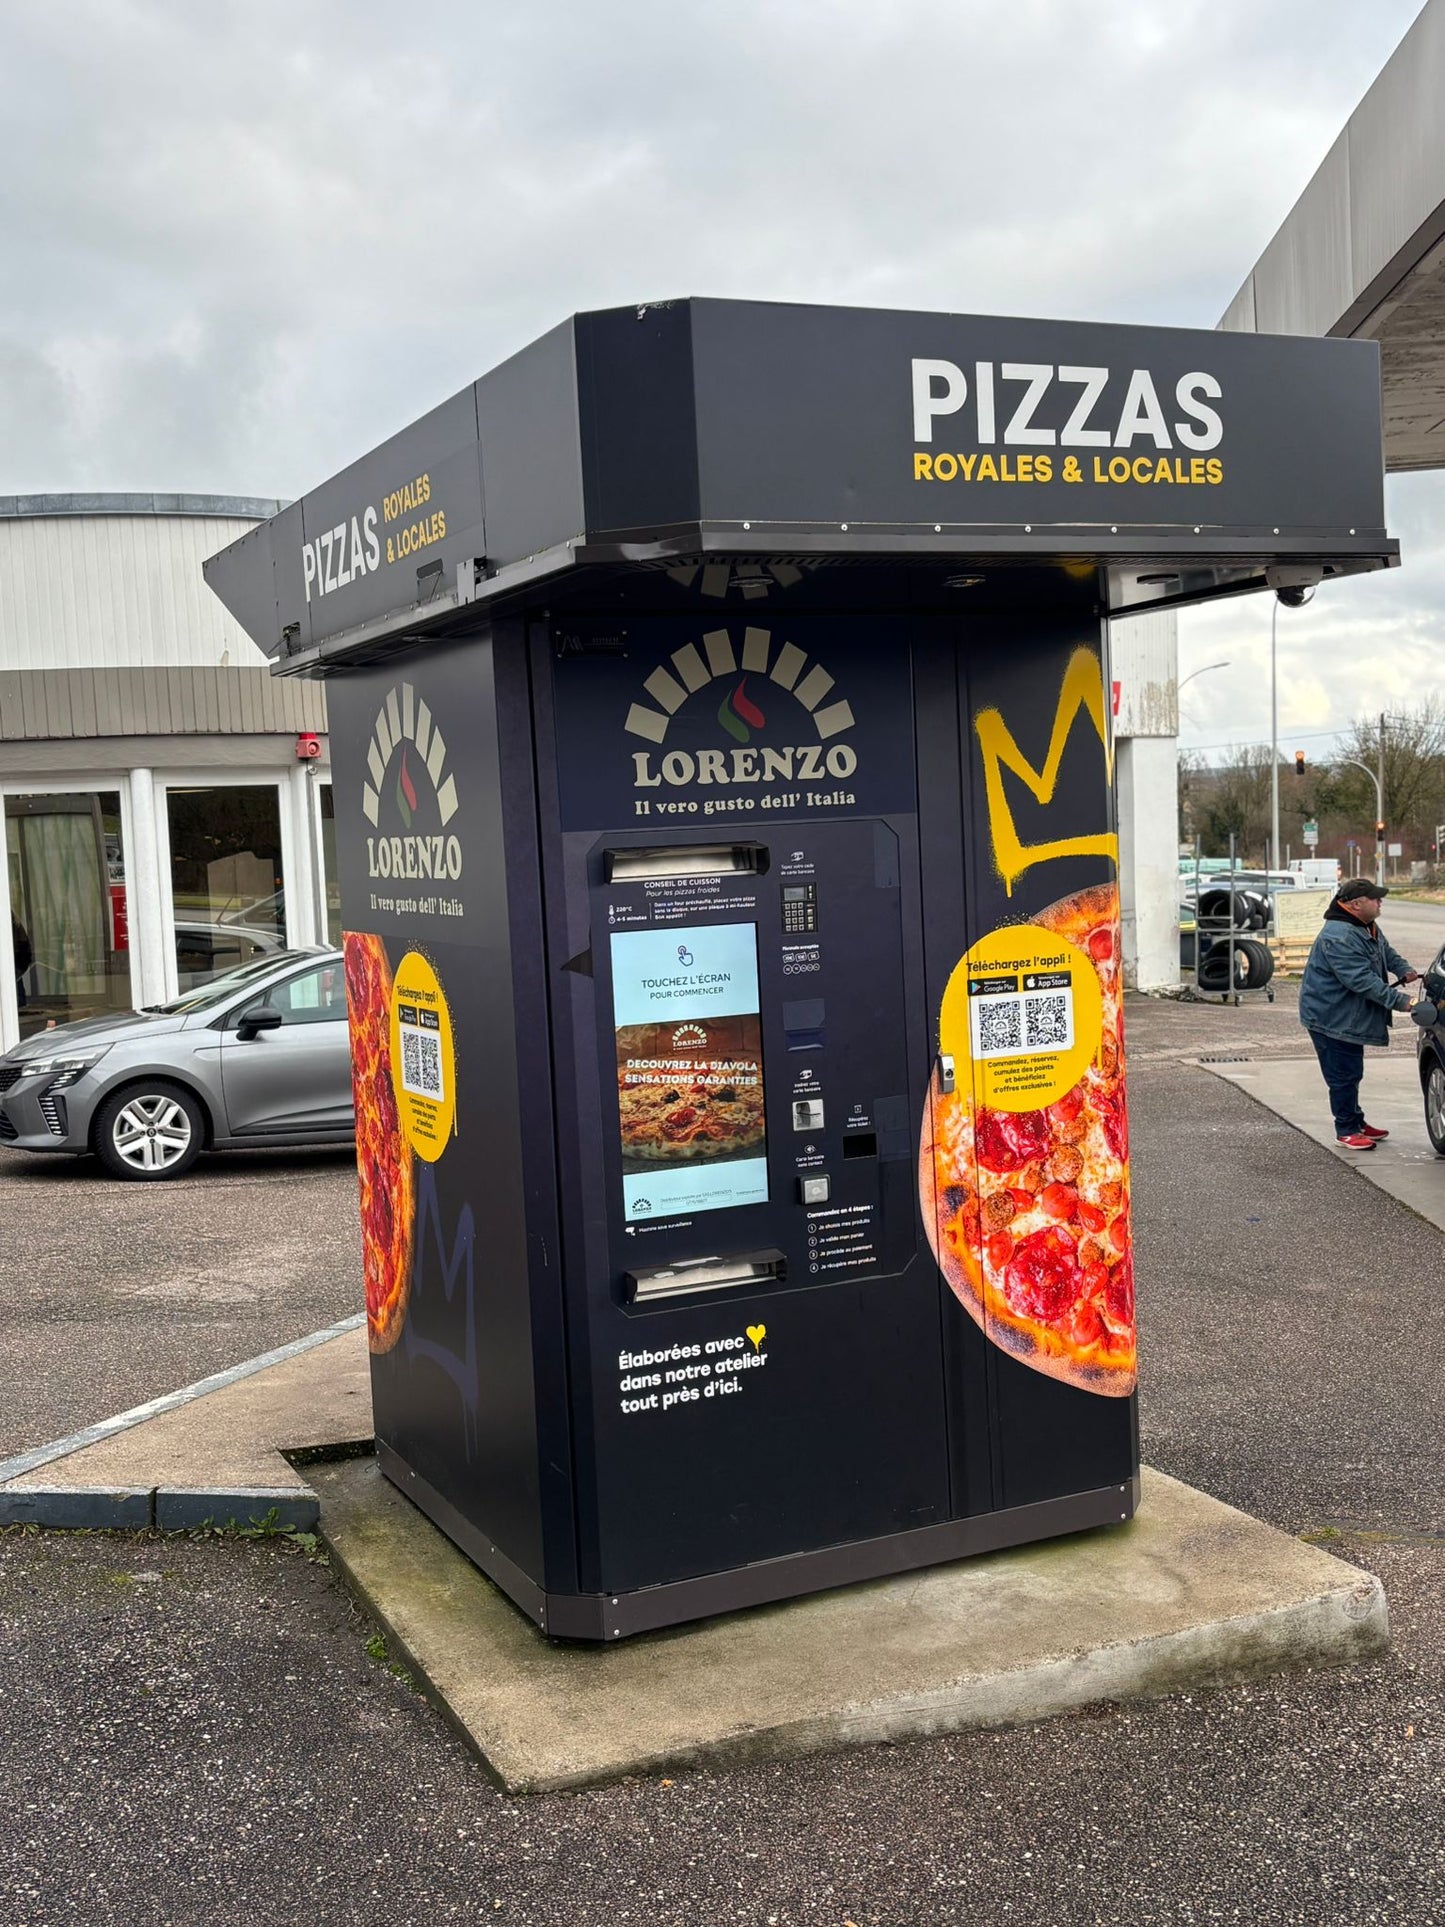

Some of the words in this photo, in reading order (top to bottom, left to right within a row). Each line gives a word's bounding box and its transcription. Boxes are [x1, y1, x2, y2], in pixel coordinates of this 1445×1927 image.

[911, 358, 1224, 451] PIZZAS
[914, 453, 1053, 482] ROYALES
[1062, 456, 1083, 483] &
[1093, 456, 1224, 484] LOCALES
[383, 473, 430, 523] ROYALES
[387, 538, 395, 564] &
[397, 510, 445, 559] LOCALES
[302, 506, 380, 603] PIZZAS
[632, 744, 857, 787] LORENZO
[635, 800, 649, 815] Il
[656, 800, 698, 814] vero
[704, 797, 755, 814] gusto
[806, 790, 855, 806] Italia
[367, 835, 462, 880] LORENZO
[644, 879, 676, 889] CONSEIL
[689, 877, 720, 886] CUISSON
[674, 888, 696, 896] pizzas
[370, 894, 376, 909] Il
[378, 898, 394, 912] vero
[396, 898, 417, 915] gusto
[439, 898, 463, 916] Italia
[966, 960, 1031, 972] Téléchargez
[641, 976, 688, 988] TOUCHEZ
[650, 991, 672, 1000] POUR
[673, 987, 724, 997] COMMENCER
[672, 1038, 707, 1047] LORENZO
[627, 1059, 691, 1070] DECOUVREZ
[694, 1060, 707, 1070] LA
[710, 1060, 757, 1070] DIAVOLA
[1034, 1064, 1054, 1073] points
[625, 1074, 694, 1084] SENSATIONS
[697, 1075, 758, 1085] GARANTIES
[1014, 1074, 1046, 1082] bénéficiez
[1021, 1082, 1052, 1090] exclusives
[807, 1209, 839, 1218] Commandez
[619, 1344, 701, 1370] Élaborées
[705, 1336, 744, 1354] avec
[620, 1374, 661, 1392] dans
[666, 1364, 711, 1383] notre
[715, 1352, 768, 1374] atelier
[620, 1395, 658, 1414] tout
[663, 1386, 700, 1410] près
